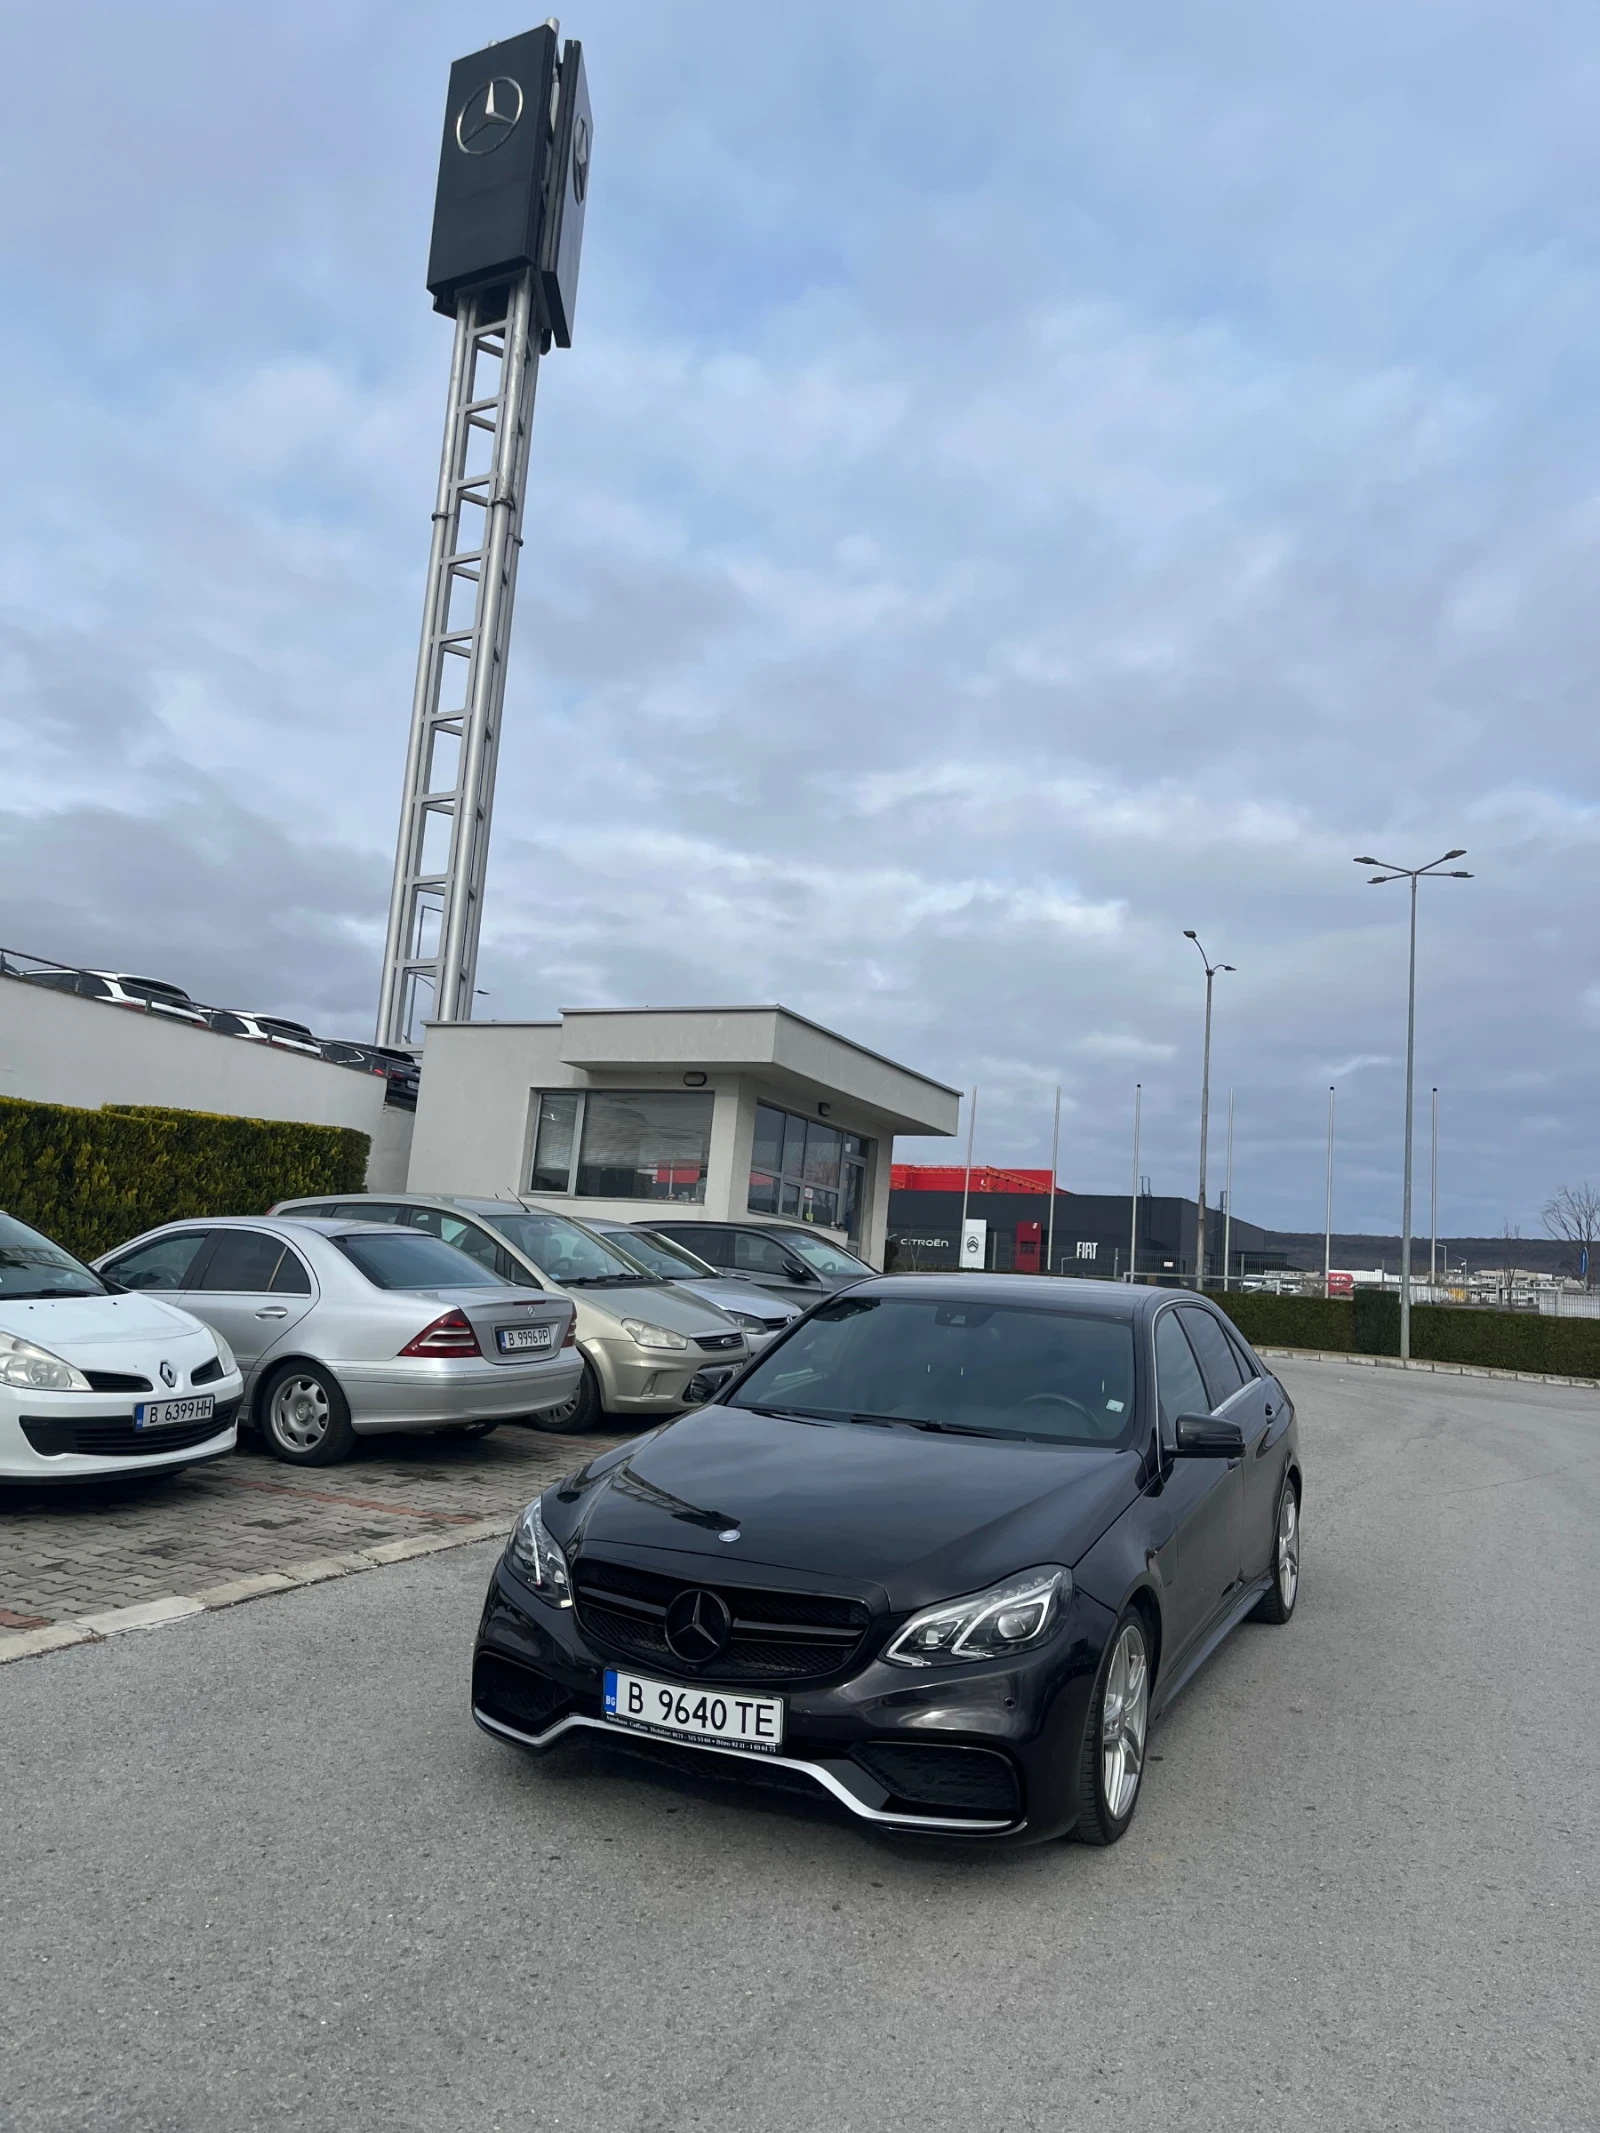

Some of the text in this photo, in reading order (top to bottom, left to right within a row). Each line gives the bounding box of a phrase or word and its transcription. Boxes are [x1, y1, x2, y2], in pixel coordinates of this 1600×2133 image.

[1076, 1241, 1098, 1260] FIAT
[508, 1332, 514, 1346] B
[518, 1330, 538, 1345] 9996
[538, 1330, 548, 1343] PP
[150, 1399, 212, 1424] B 6399 HH
[606, 1695, 616, 1706] BG
[628, 1682, 774, 1738] B 9640 TE
